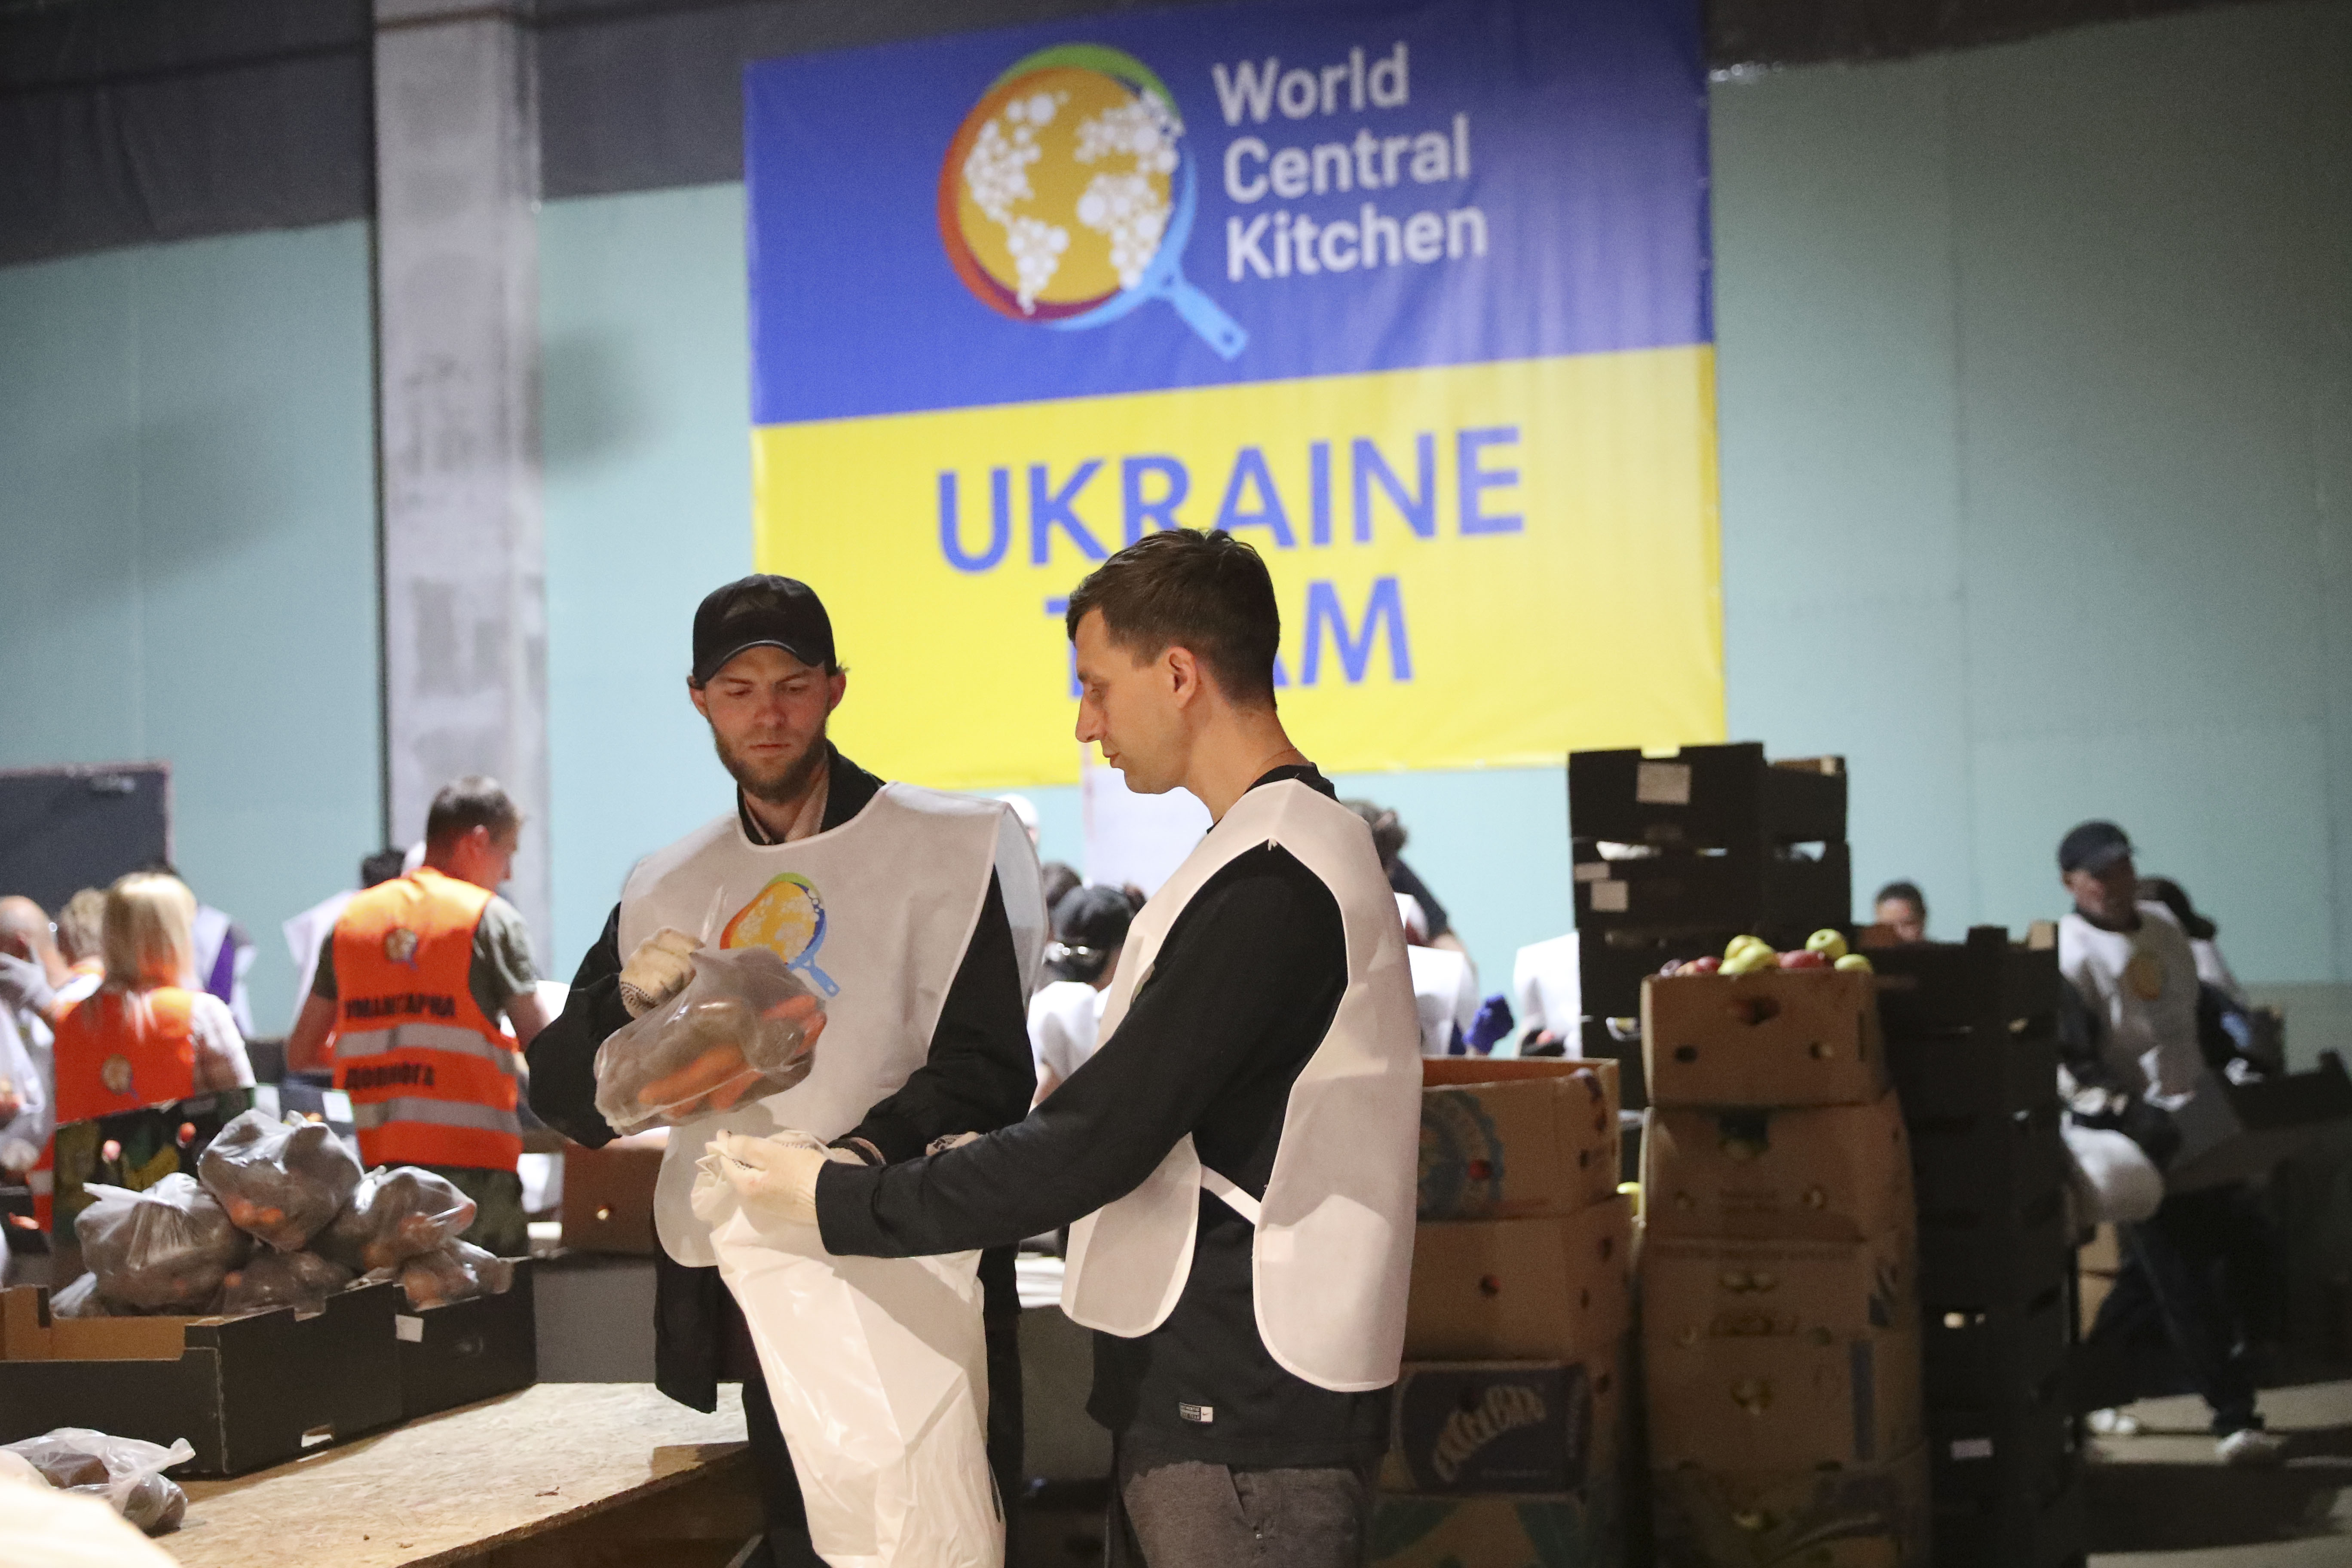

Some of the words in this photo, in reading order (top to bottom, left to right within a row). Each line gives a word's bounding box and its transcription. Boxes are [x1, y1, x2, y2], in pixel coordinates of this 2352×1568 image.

[1212, 42, 1409, 125] World
[1224, 113, 1470, 202] Central
[1227, 204, 1487, 280] Kitchen
[937, 426, 1523, 573] UKRAINE
